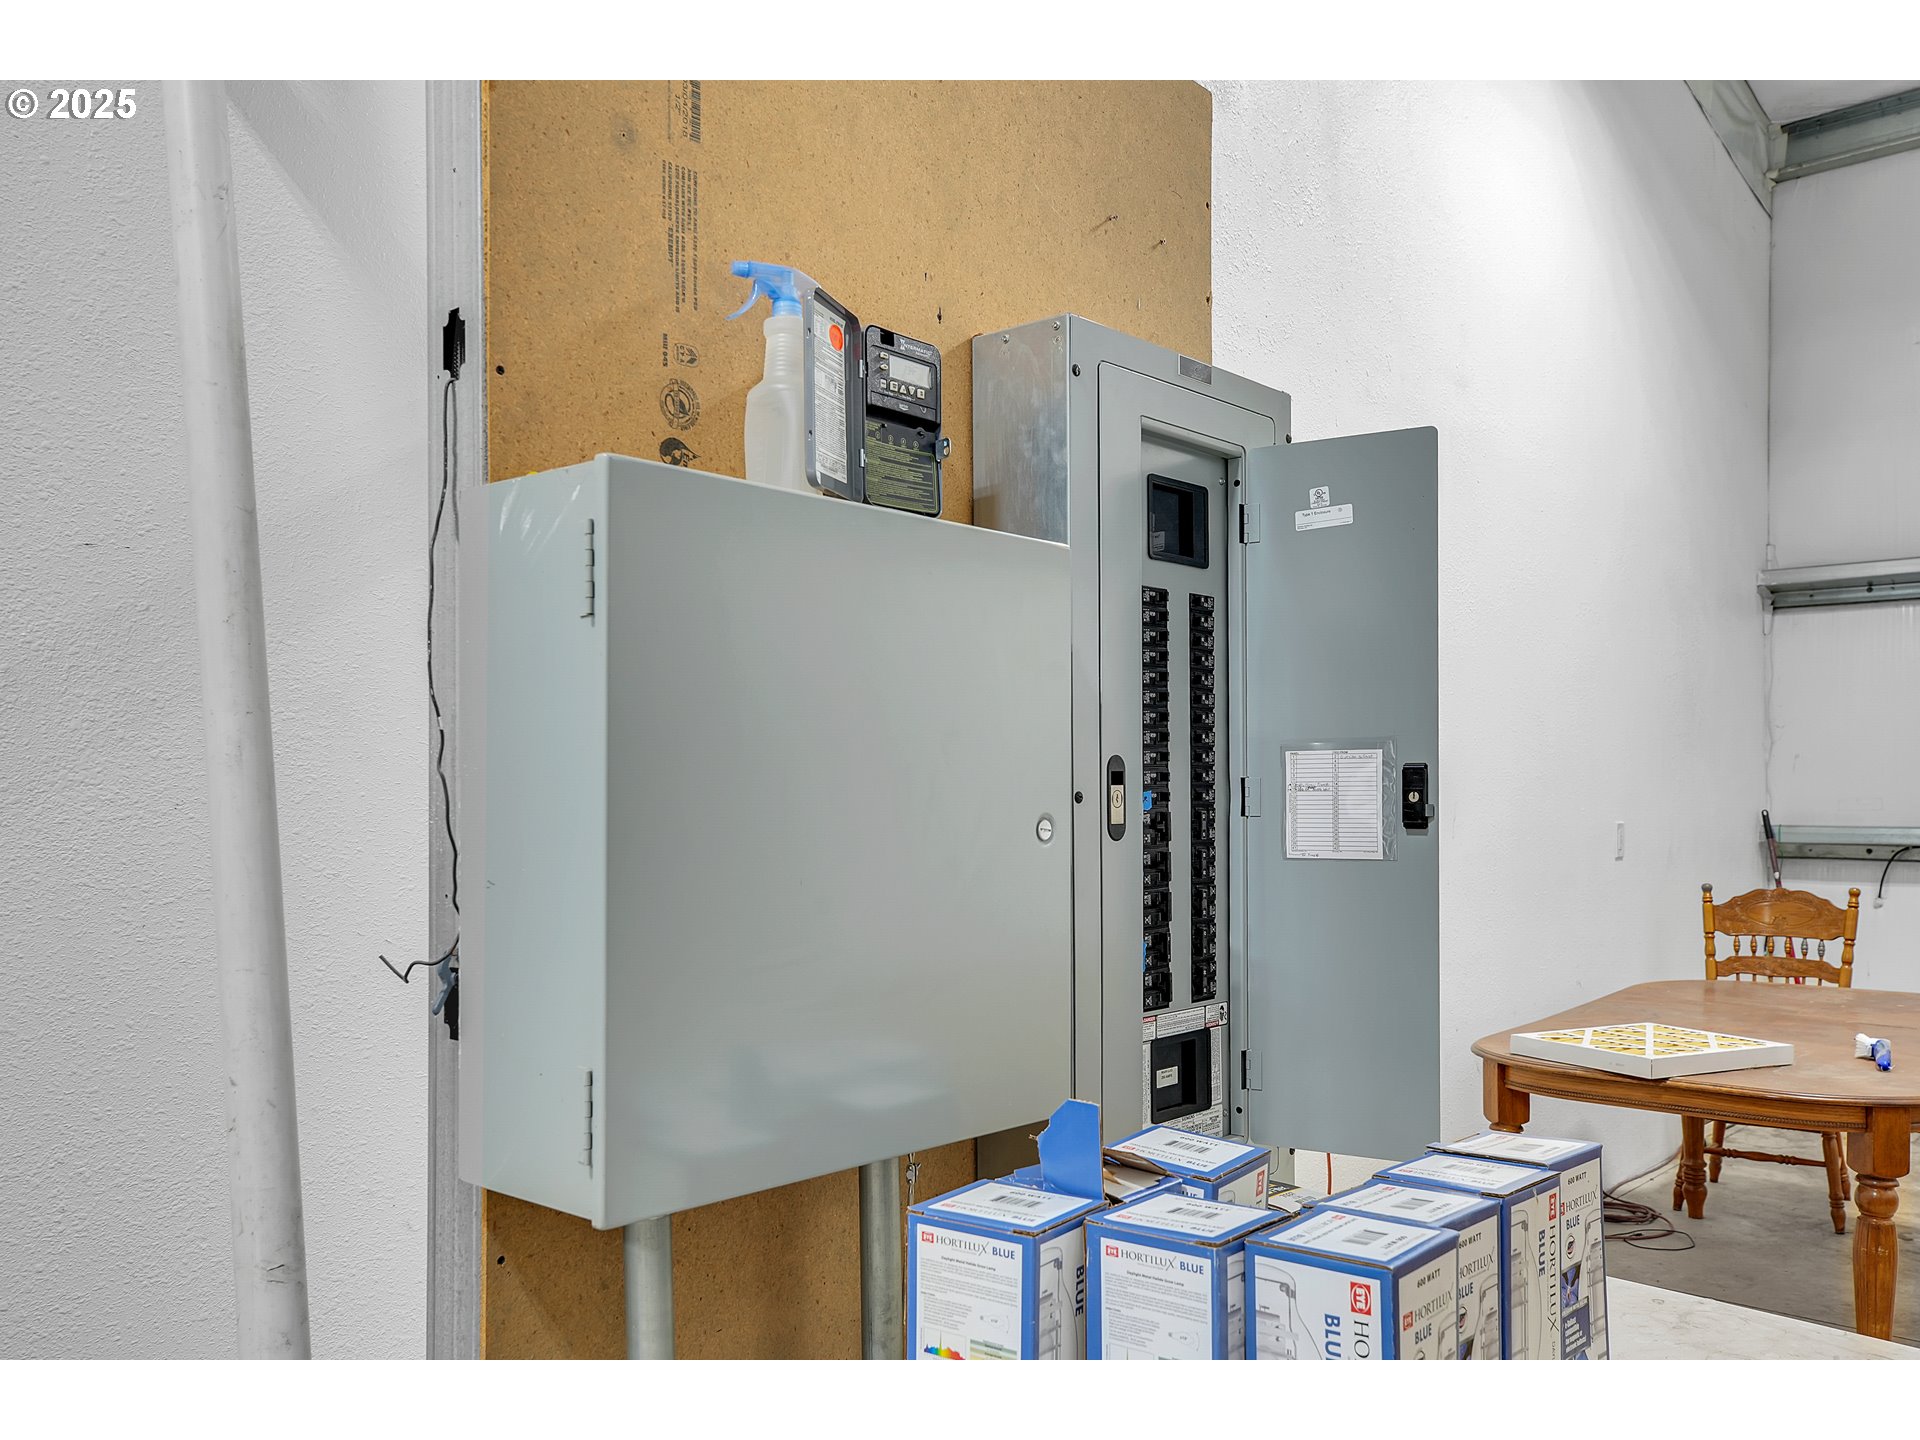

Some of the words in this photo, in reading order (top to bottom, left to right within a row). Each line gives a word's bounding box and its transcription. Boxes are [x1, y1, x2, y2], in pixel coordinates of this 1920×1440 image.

[1567, 1175, 1576, 1186] 600
[1576, 1171, 1587, 1183] WATT
[1566, 1185, 1598, 1213] HORTILUX
[1566, 1214, 1581, 1230] BLUE
[936, 1235, 990, 1256] HORTILUX
[992, 1246, 1016, 1260] BLUE
[1469, 1232, 1482, 1246] WATT
[1121, 1249, 1176, 1271] HORTILUX
[1180, 1261, 1204, 1275] BLUE
[1538, 1229, 1546, 1278] BLUE
[1075, 1265, 1085, 1317] BLUE
[1416, 1275, 1426, 1289] 600
[1426, 1268, 1440, 1283] WATT
[1548, 1225, 1560, 1332] HORTILUX
[1414, 1282, 1454, 1320] HORTILUX
[1414, 1323, 1433, 1345] BLUE
